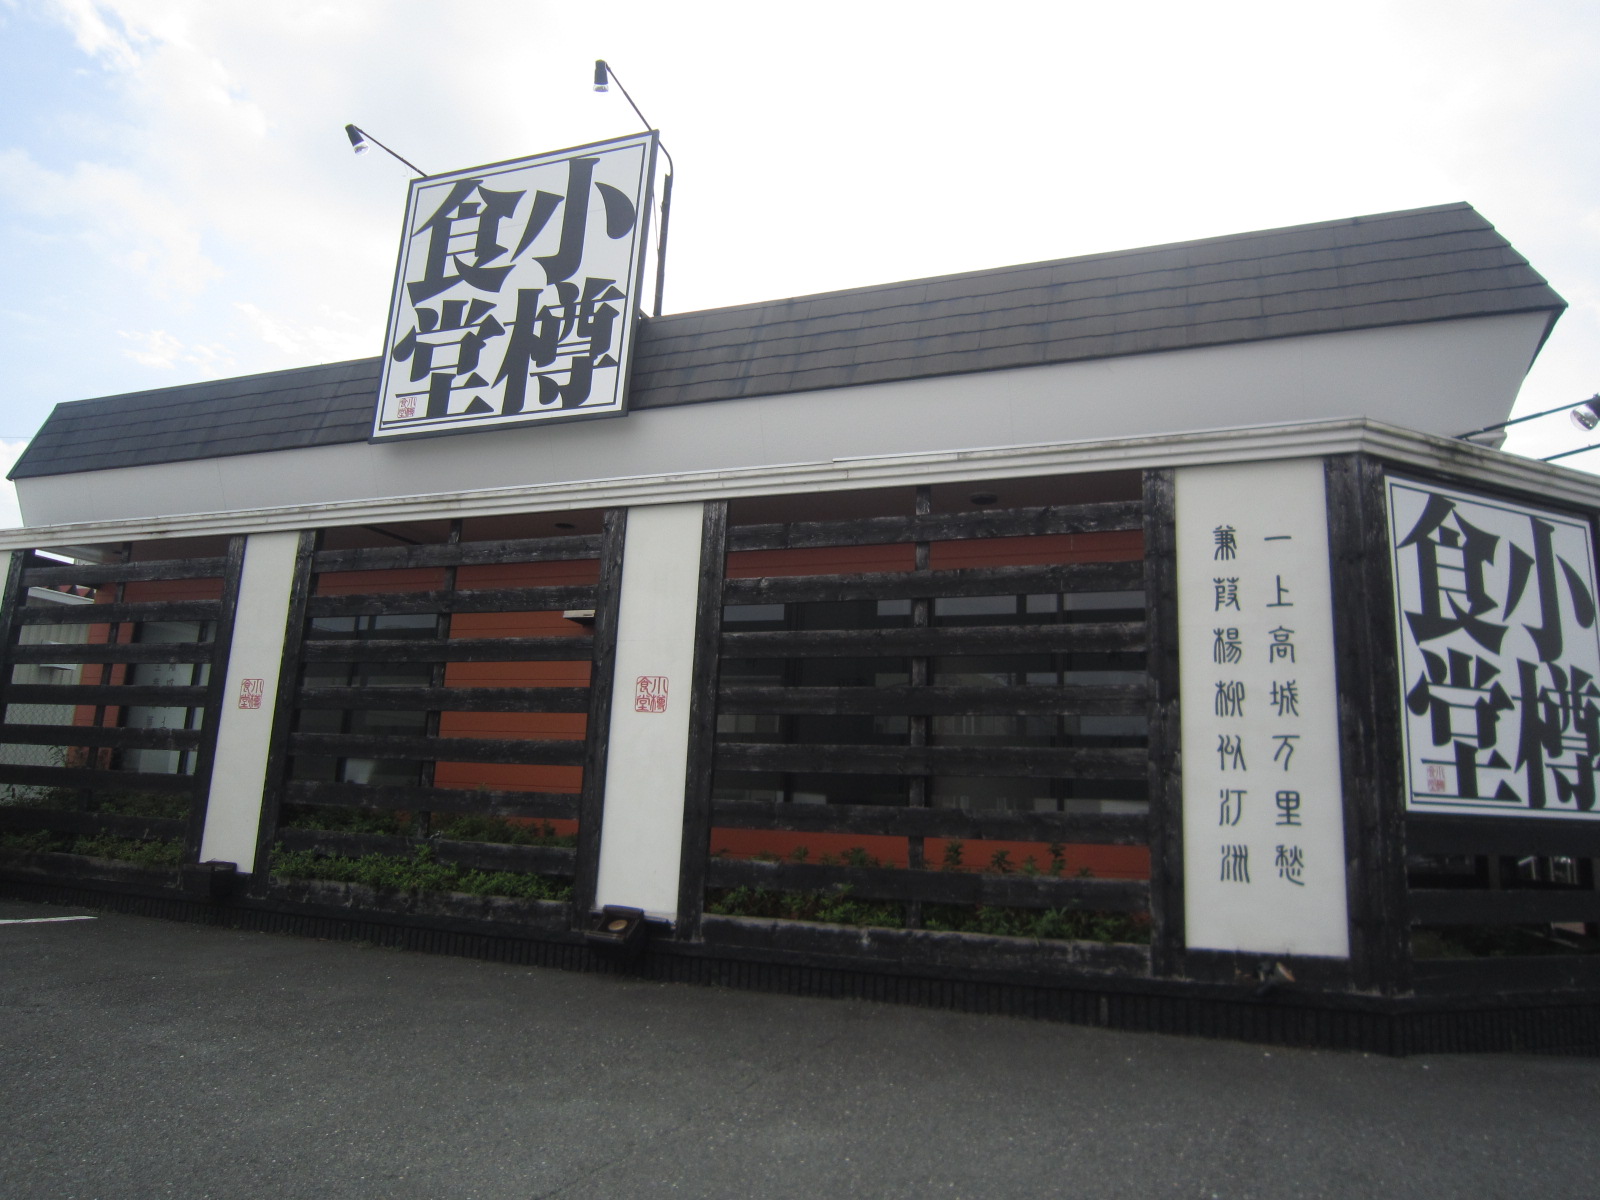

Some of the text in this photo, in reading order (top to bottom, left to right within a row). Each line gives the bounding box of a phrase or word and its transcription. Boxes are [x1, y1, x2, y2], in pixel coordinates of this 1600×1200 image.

[383, 179, 527, 424] 食堂
[491, 158, 636, 415] 小樽
[1396, 493, 1522, 803] 食堂
[1502, 515, 1600, 810] 小樽
